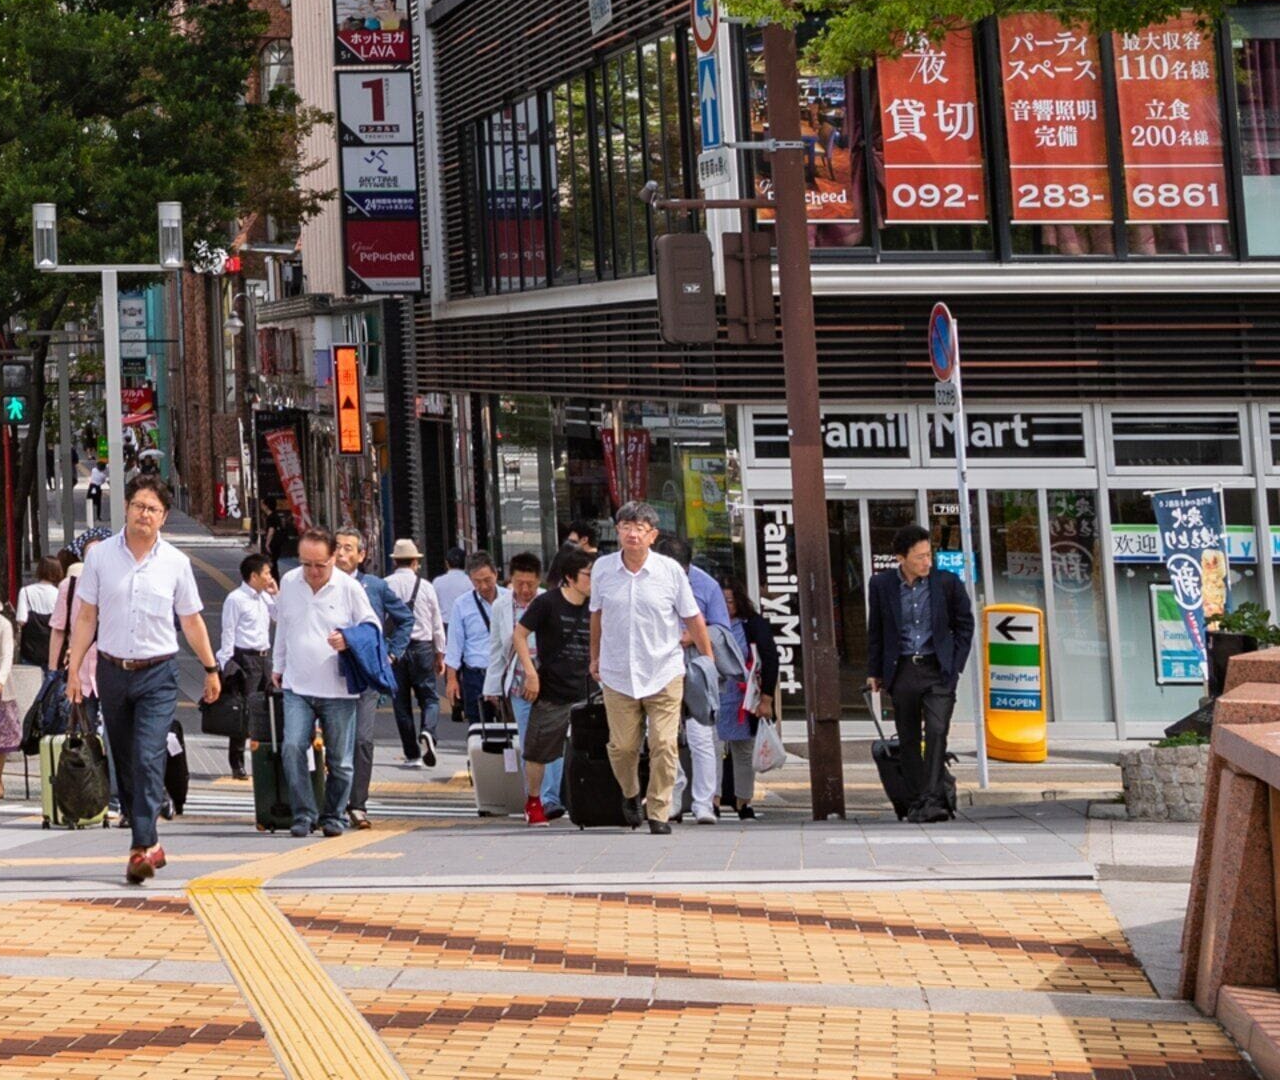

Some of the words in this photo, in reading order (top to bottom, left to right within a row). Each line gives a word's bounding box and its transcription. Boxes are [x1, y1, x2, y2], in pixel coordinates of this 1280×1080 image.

[351, 31, 404, 43] ホットヨガ
[1009, 32, 1088, 56] パーティ
[1122, 32, 1201, 51] 最大収容
[361, 44, 400, 58] LAVA
[1006, 60, 1097, 81] スペース
[1119, 54, 1210, 80] 110名様
[885, 98, 975, 142] 貸切
[1010, 99, 1097, 121] 音響照明
[1145, 98, 1190, 120] 立食
[1034, 125, 1078, 147] 完備
[1131, 125, 1210, 147] 200名様
[892, 183, 980, 208] 092-
[1018, 183, 1105, 208] 283-
[1132, 183, 1220, 208] 6861
[1114, 533, 1158, 555] 欢迎
[990, 672, 1039, 683] FamilyMart
[996, 697, 1008, 706] 24
[1008, 698, 1037, 708] OPEN
